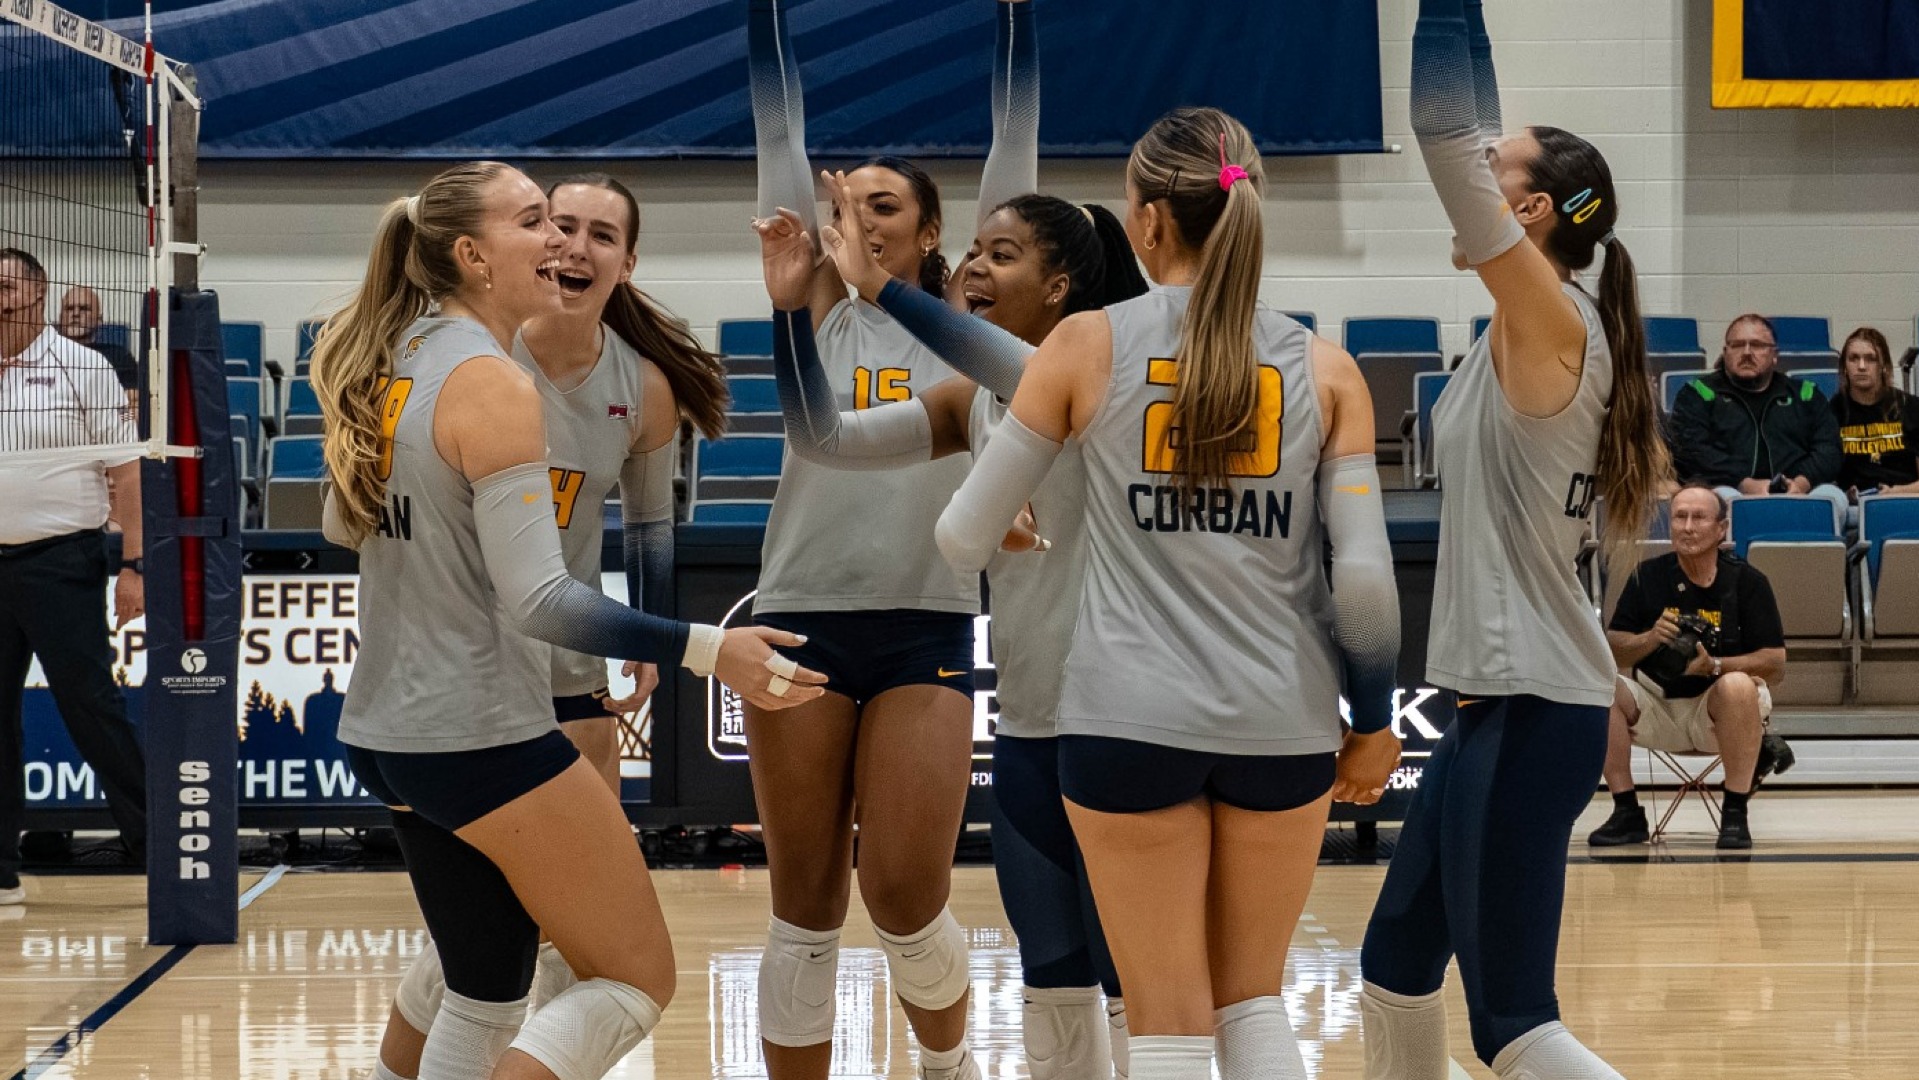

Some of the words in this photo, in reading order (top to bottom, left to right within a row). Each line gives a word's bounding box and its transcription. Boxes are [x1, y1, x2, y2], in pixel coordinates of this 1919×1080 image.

[852, 365, 912, 410] 15
[1843, 436, 1905, 454] VOLLEYBALL
[1128, 483, 1292, 539] CORBAN
[241, 582, 356, 618] EFFE
[24, 762, 106, 800] OM
[237, 759, 308, 798] HE
